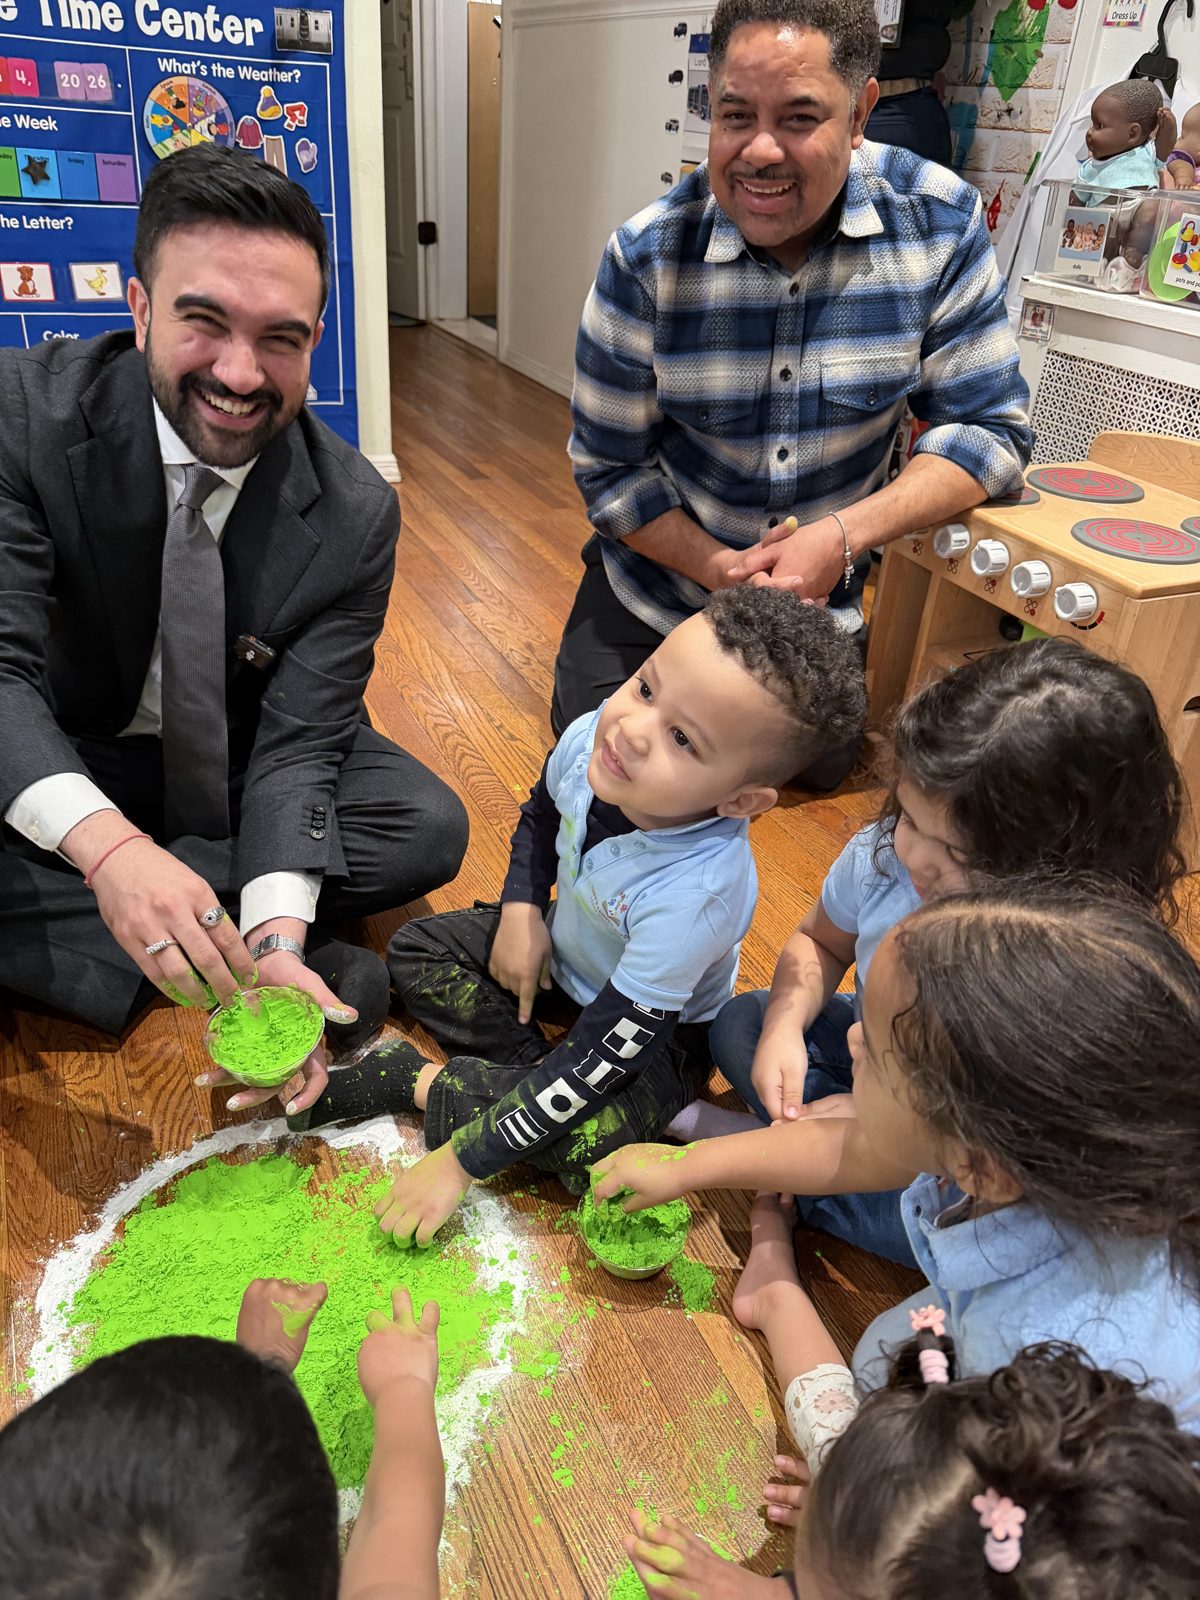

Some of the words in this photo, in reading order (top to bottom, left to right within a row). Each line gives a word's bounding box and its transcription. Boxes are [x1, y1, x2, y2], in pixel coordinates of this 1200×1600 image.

[39, 0, 124, 32] Time
[135, 0, 264, 46] Center
[1112, 11, 1128, 19] Dress
[157, 57, 208, 76] What's
[211, 63, 235, 79] the
[238, 65, 301, 83] Weather?
[14, 114, 58, 131] Week
[22, 215, 74, 230] Letter?
